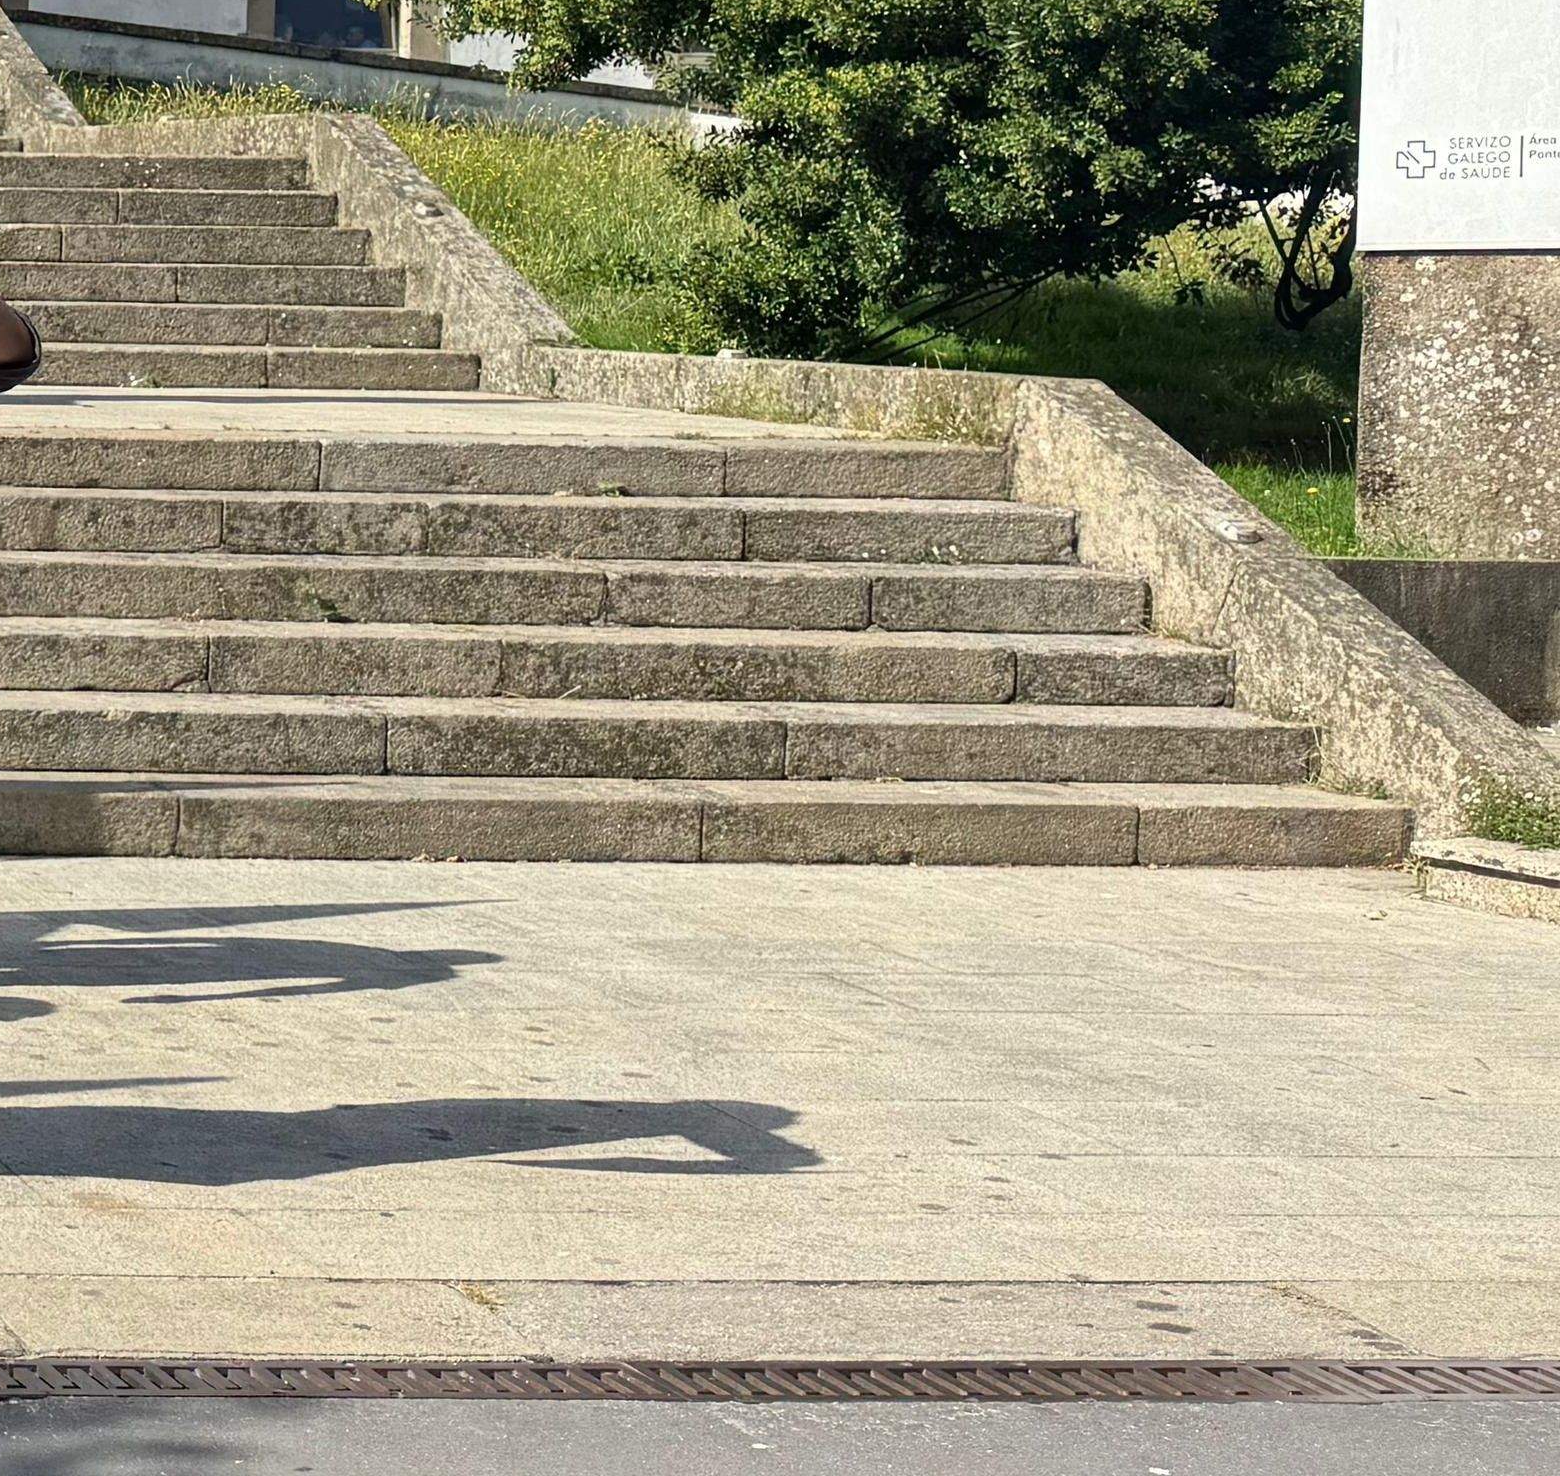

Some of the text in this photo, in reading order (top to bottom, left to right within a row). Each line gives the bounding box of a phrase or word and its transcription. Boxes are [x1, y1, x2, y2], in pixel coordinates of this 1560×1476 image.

[1449, 136, 1511, 149] SERVIZO
[1530, 133, 1557, 144] Área
[1448, 151, 1511, 164] GALEGO
[1440, 168, 1456, 180] de
